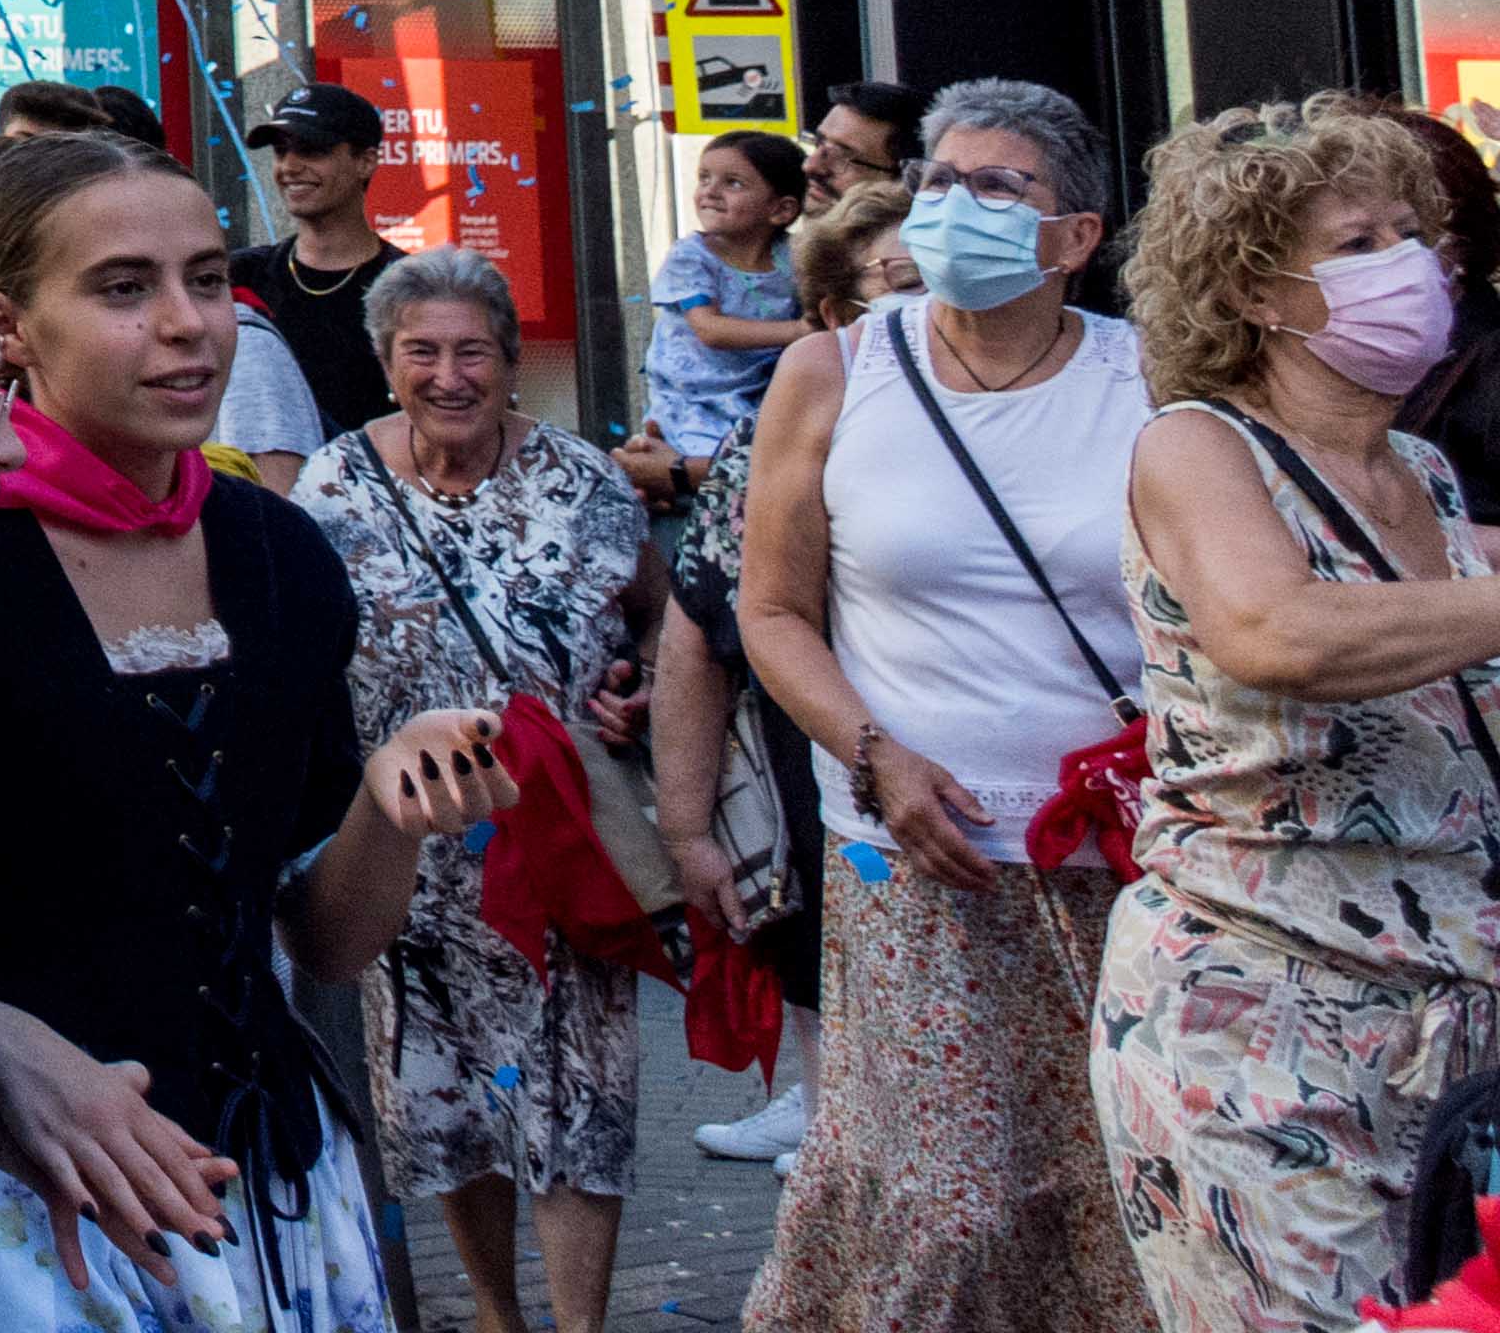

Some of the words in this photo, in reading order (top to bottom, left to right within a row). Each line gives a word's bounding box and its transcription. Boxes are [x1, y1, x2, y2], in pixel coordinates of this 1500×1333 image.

[380, 108, 411, 134] ER
[412, 108, 448, 138] TU,
[412, 139, 509, 166] PRIMERS.
